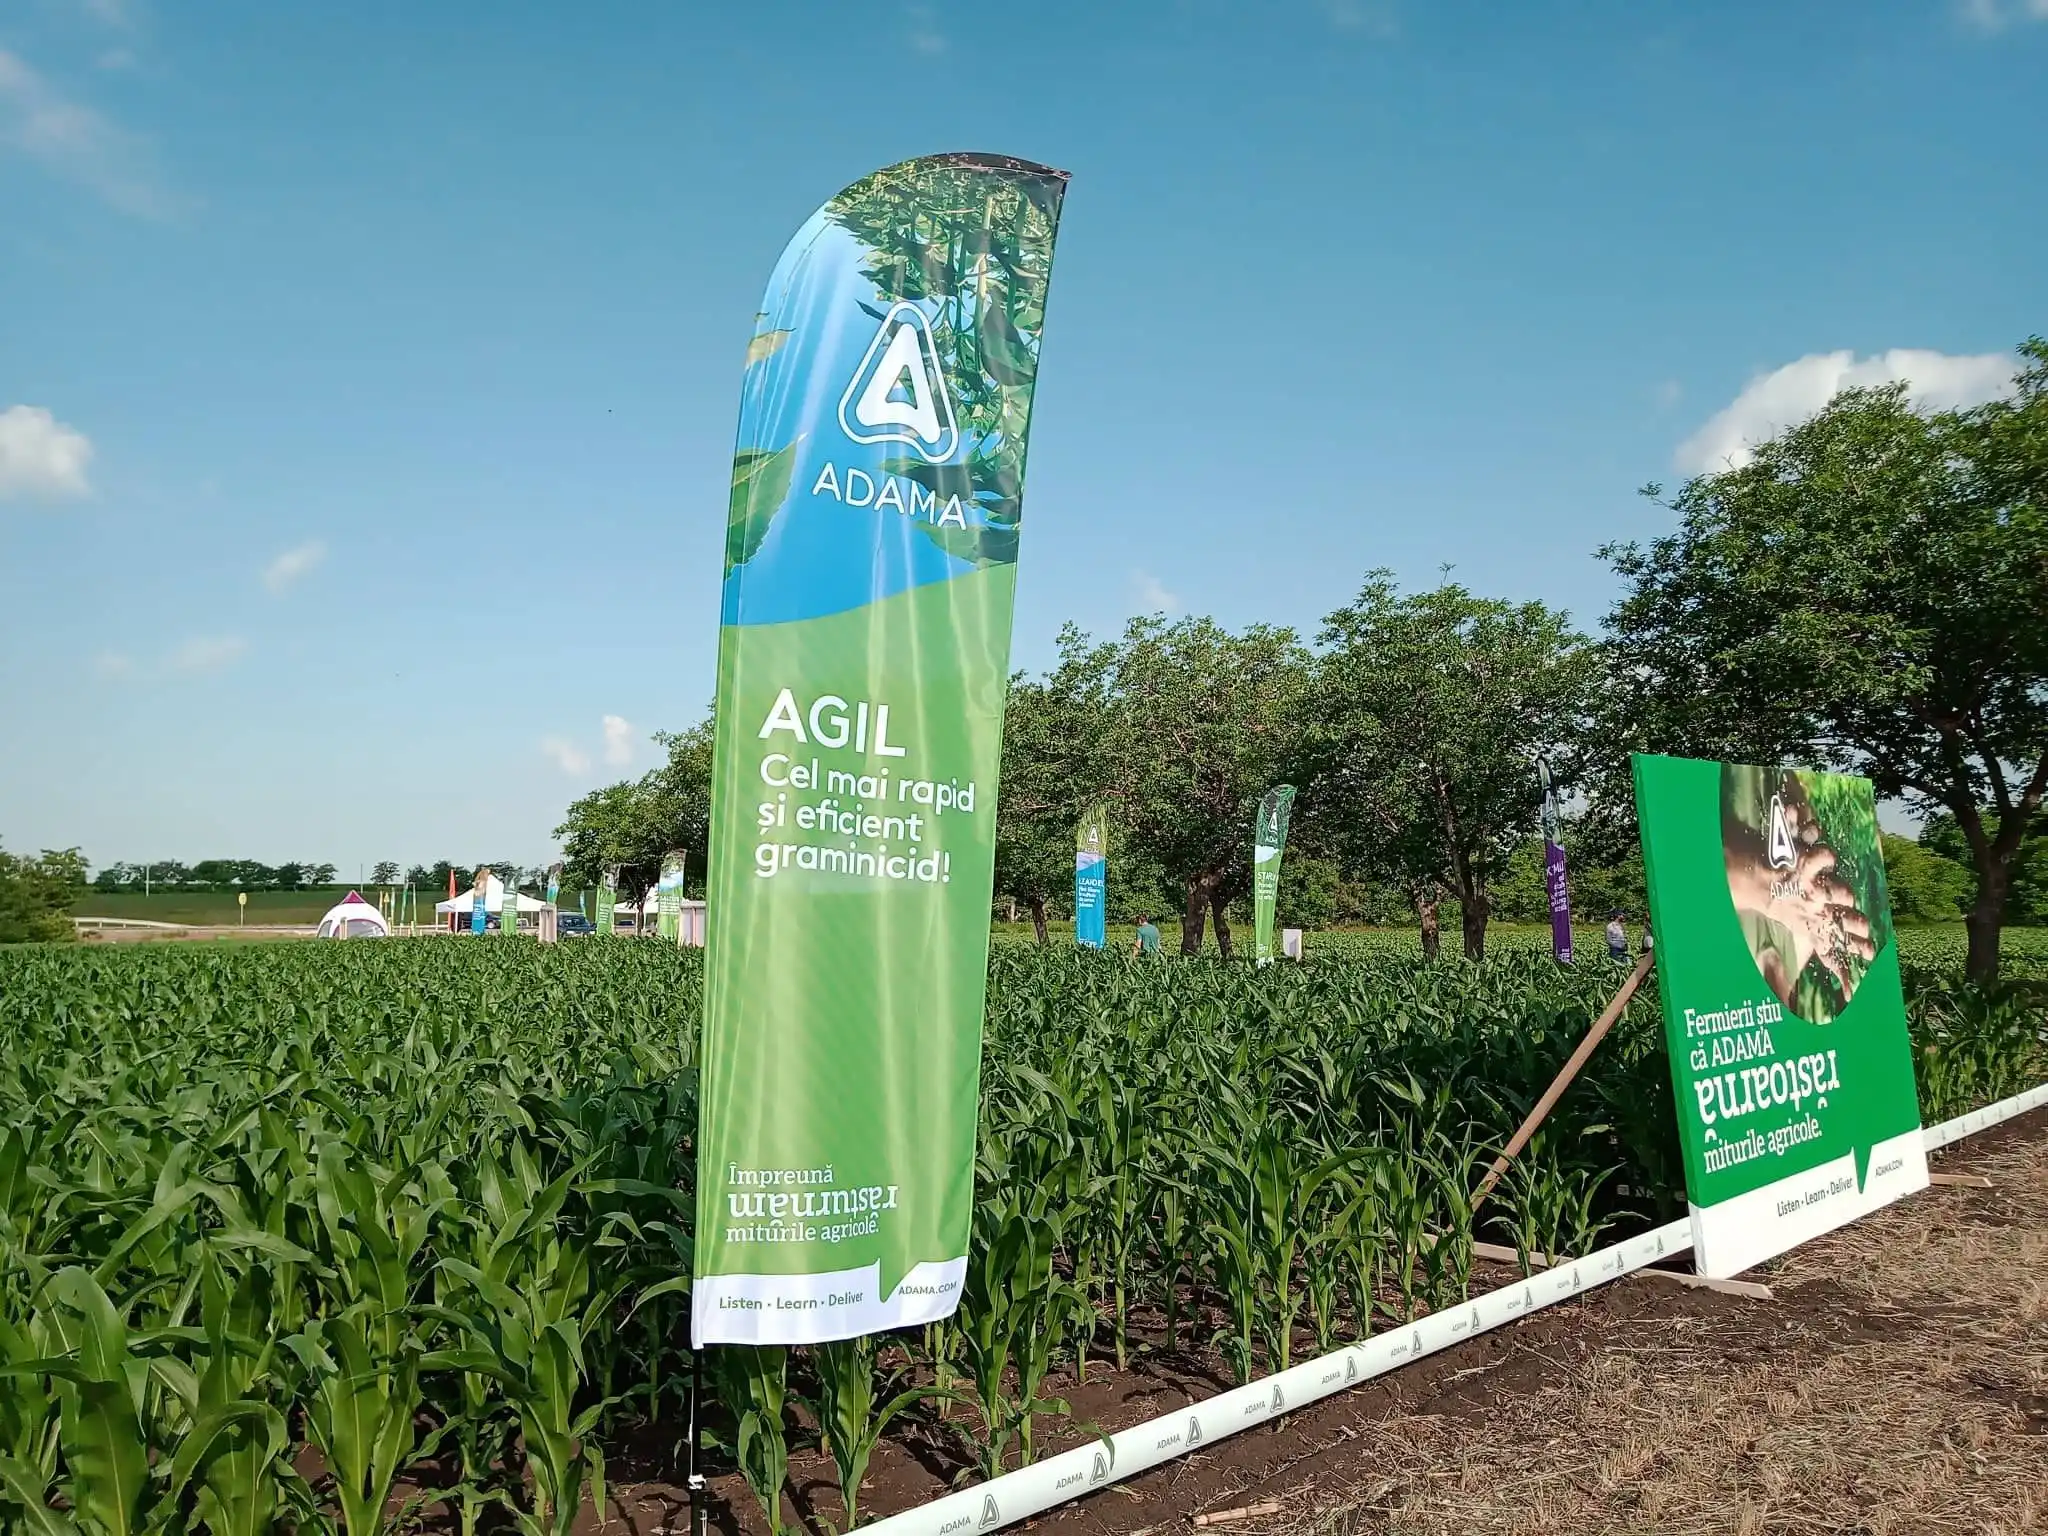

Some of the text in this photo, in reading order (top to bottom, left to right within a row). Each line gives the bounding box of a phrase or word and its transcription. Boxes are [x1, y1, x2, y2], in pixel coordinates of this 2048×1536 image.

[812, 462, 967, 530] ADAMA
[758, 687, 906, 757] AGIL
[760, 753, 975, 815] Cel mai rapid
[757, 793, 923, 842] și eficient
[755, 841, 950, 883] graminicid!
[1770, 881, 1806, 899] ADAMA
[1684, 1000, 1755, 1038] Fermierii
[1690, 1029, 1775, 1071] că ADAMA
[1704, 1112, 1822, 1174] miturile agricole.
[728, 1161, 833, 1188] Împreună
[1777, 1177, 1853, 1217] Listen Learn Deliver
[726, 1215, 879, 1243] miturile agricole.
[719, 1291, 864, 1310] Listen Learn Deliver
[898, 1281, 957, 1296] ADAMA.COM
[1321, 1370, 1341, 1385] ADAMA
[1244, 1401, 1266, 1416] ADAMA
[1156, 1433, 1181, 1450] ADAMA
[1055, 1471, 1084, 1490] ADAMA
[939, 1516, 971, 1536] ADAMA
